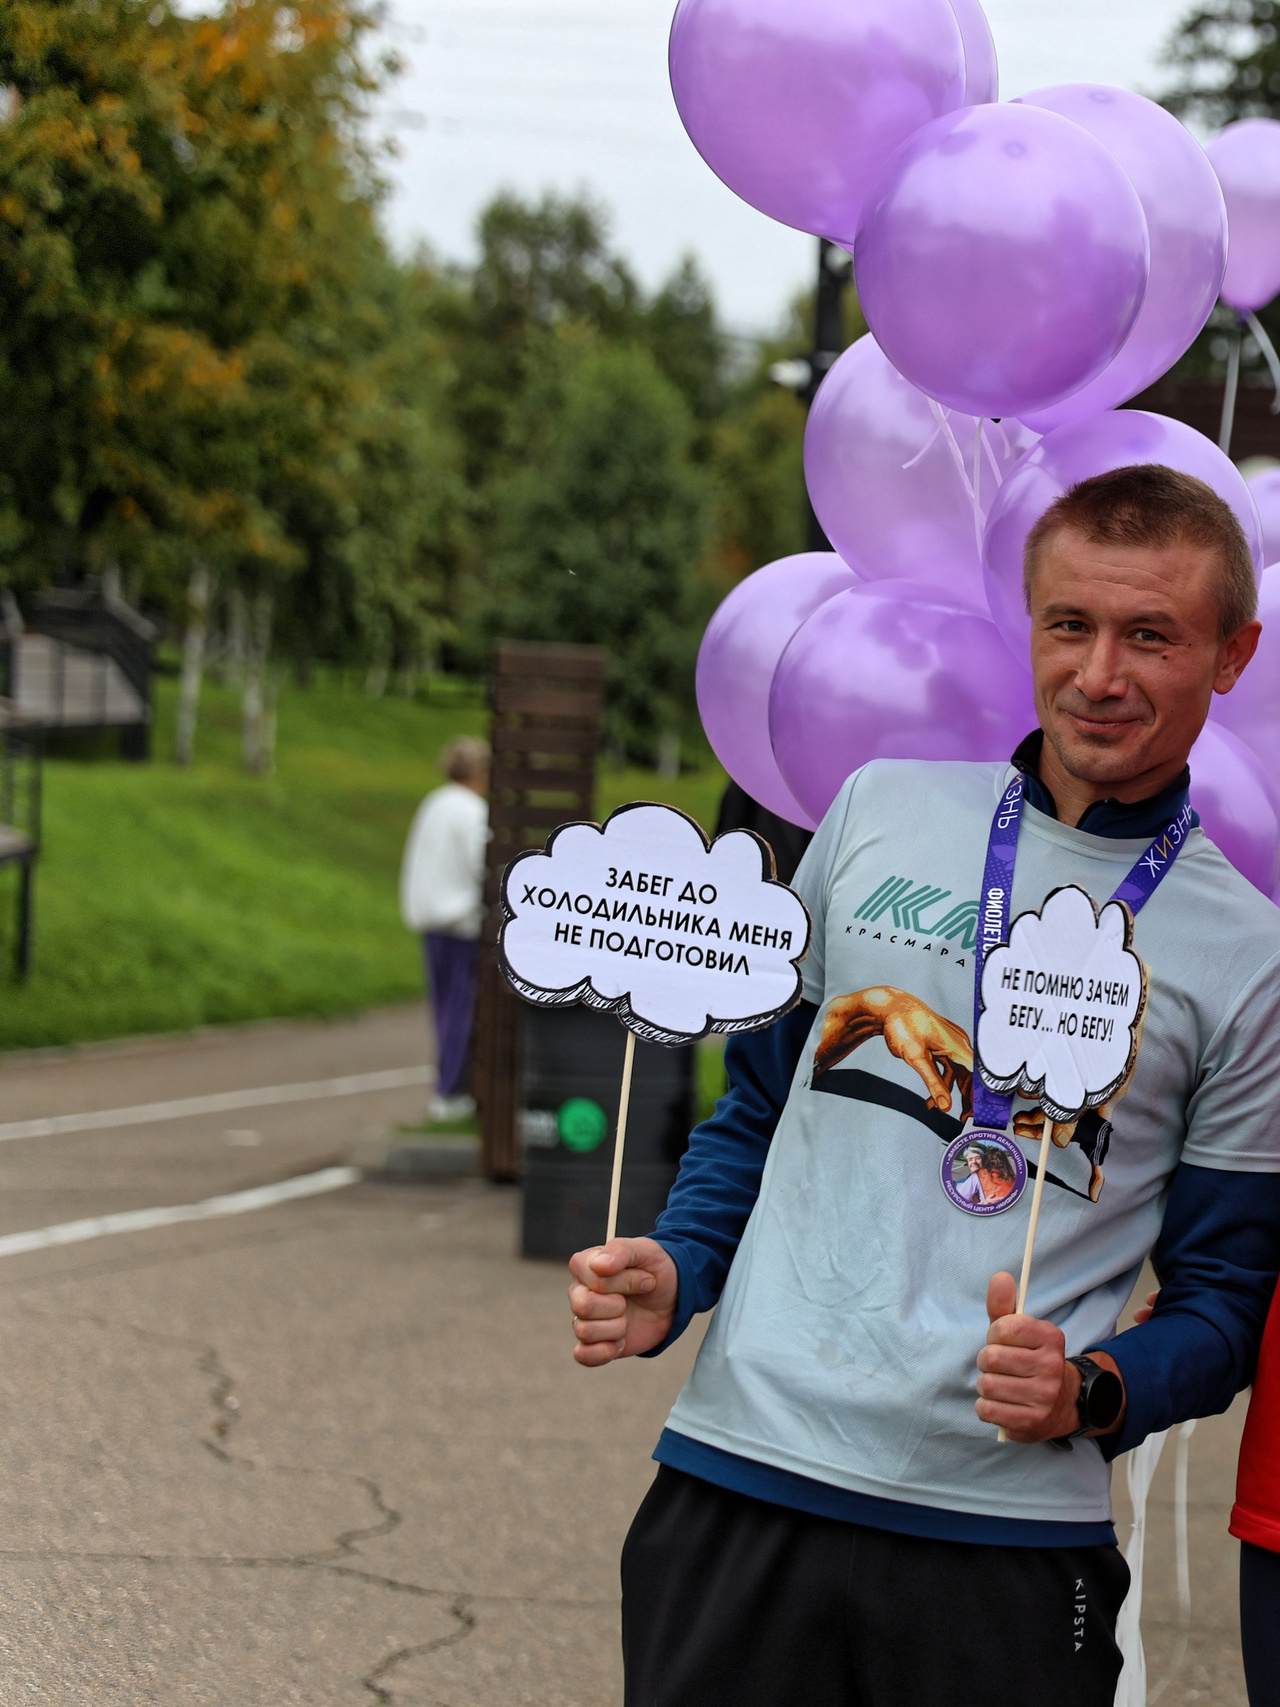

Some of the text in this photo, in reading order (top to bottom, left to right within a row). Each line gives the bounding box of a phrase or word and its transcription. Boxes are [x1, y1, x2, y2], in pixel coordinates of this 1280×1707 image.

[1138, 804, 1192, 878] ЖИЗНЬ
[605, 867, 718, 905] ЗАБЕГ ДО
[520, 884, 793, 951] ХОЛОДИЛЬНИКА МЕНЯ
[554, 922, 751, 976] НЕ ПОДГОТОВИЛ
[845, 925, 966, 968] КРАСМАРА
[1001, 967, 1130, 1007] НЕ ПОМНЮ ЗАЧЕМ
[1009, 1004, 1114, 1043] БЕГУ... НО БЕГУ!
[969, 1132, 997, 1140] ПРОТИВ
[973, 1205, 995, 1213] ЦЕНТР
[1073, 1578, 1087, 1653] KIPSTA
